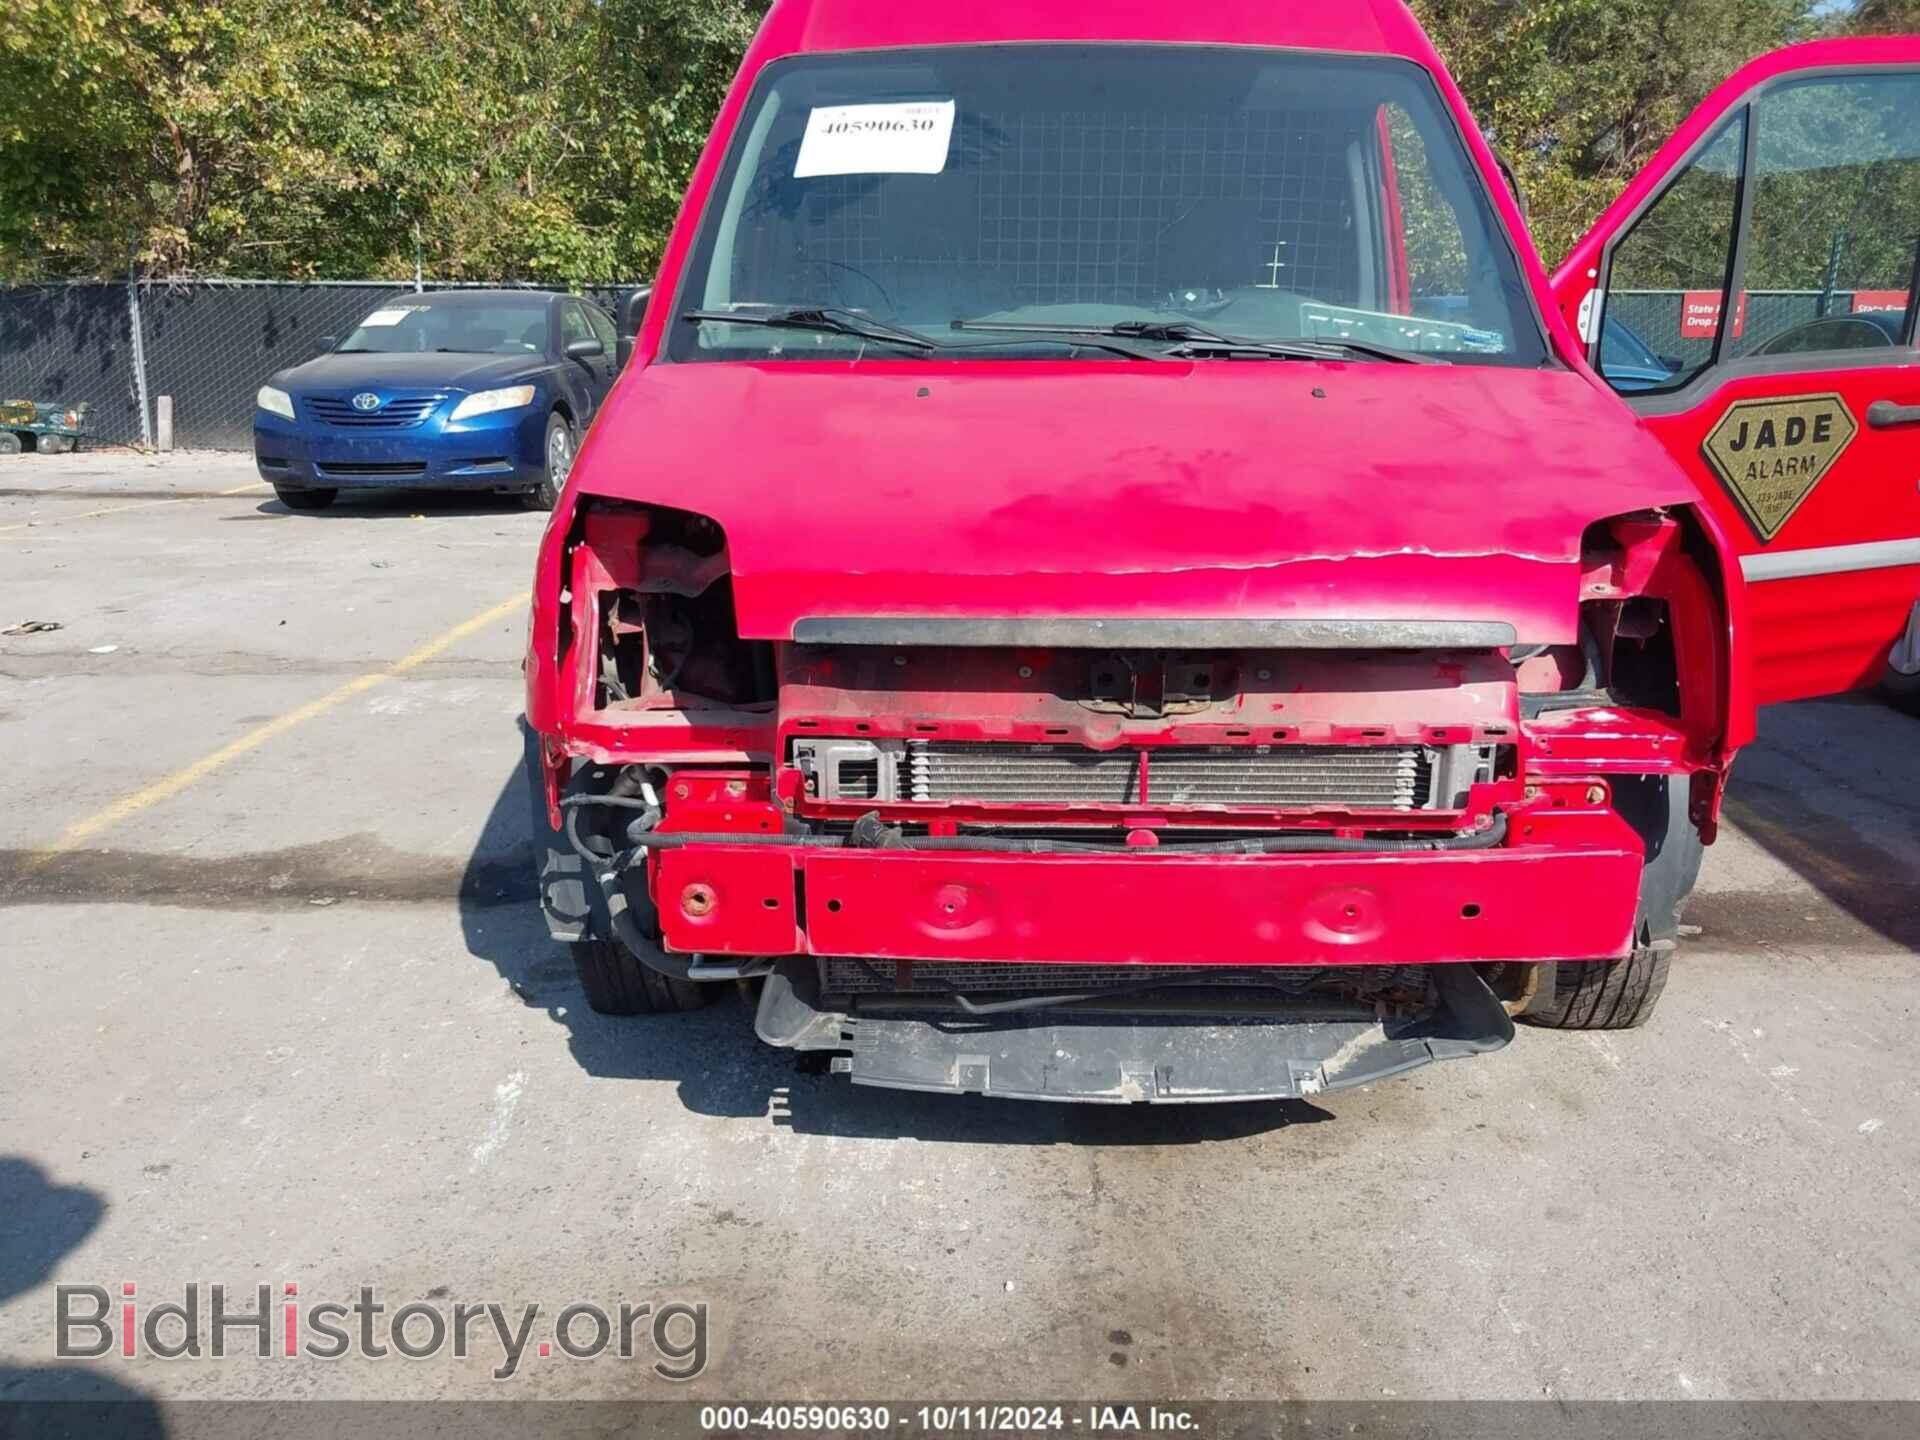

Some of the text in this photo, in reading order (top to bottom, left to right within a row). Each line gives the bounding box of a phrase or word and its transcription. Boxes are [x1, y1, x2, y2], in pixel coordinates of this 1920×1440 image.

[821, 119, 934, 135] 40590630
[1687, 304, 1713, 314] State
[1687, 316, 1712, 328] Drop
[1730, 414, 1832, 452] JADE
[1745, 455, 1816, 480] ALARM
